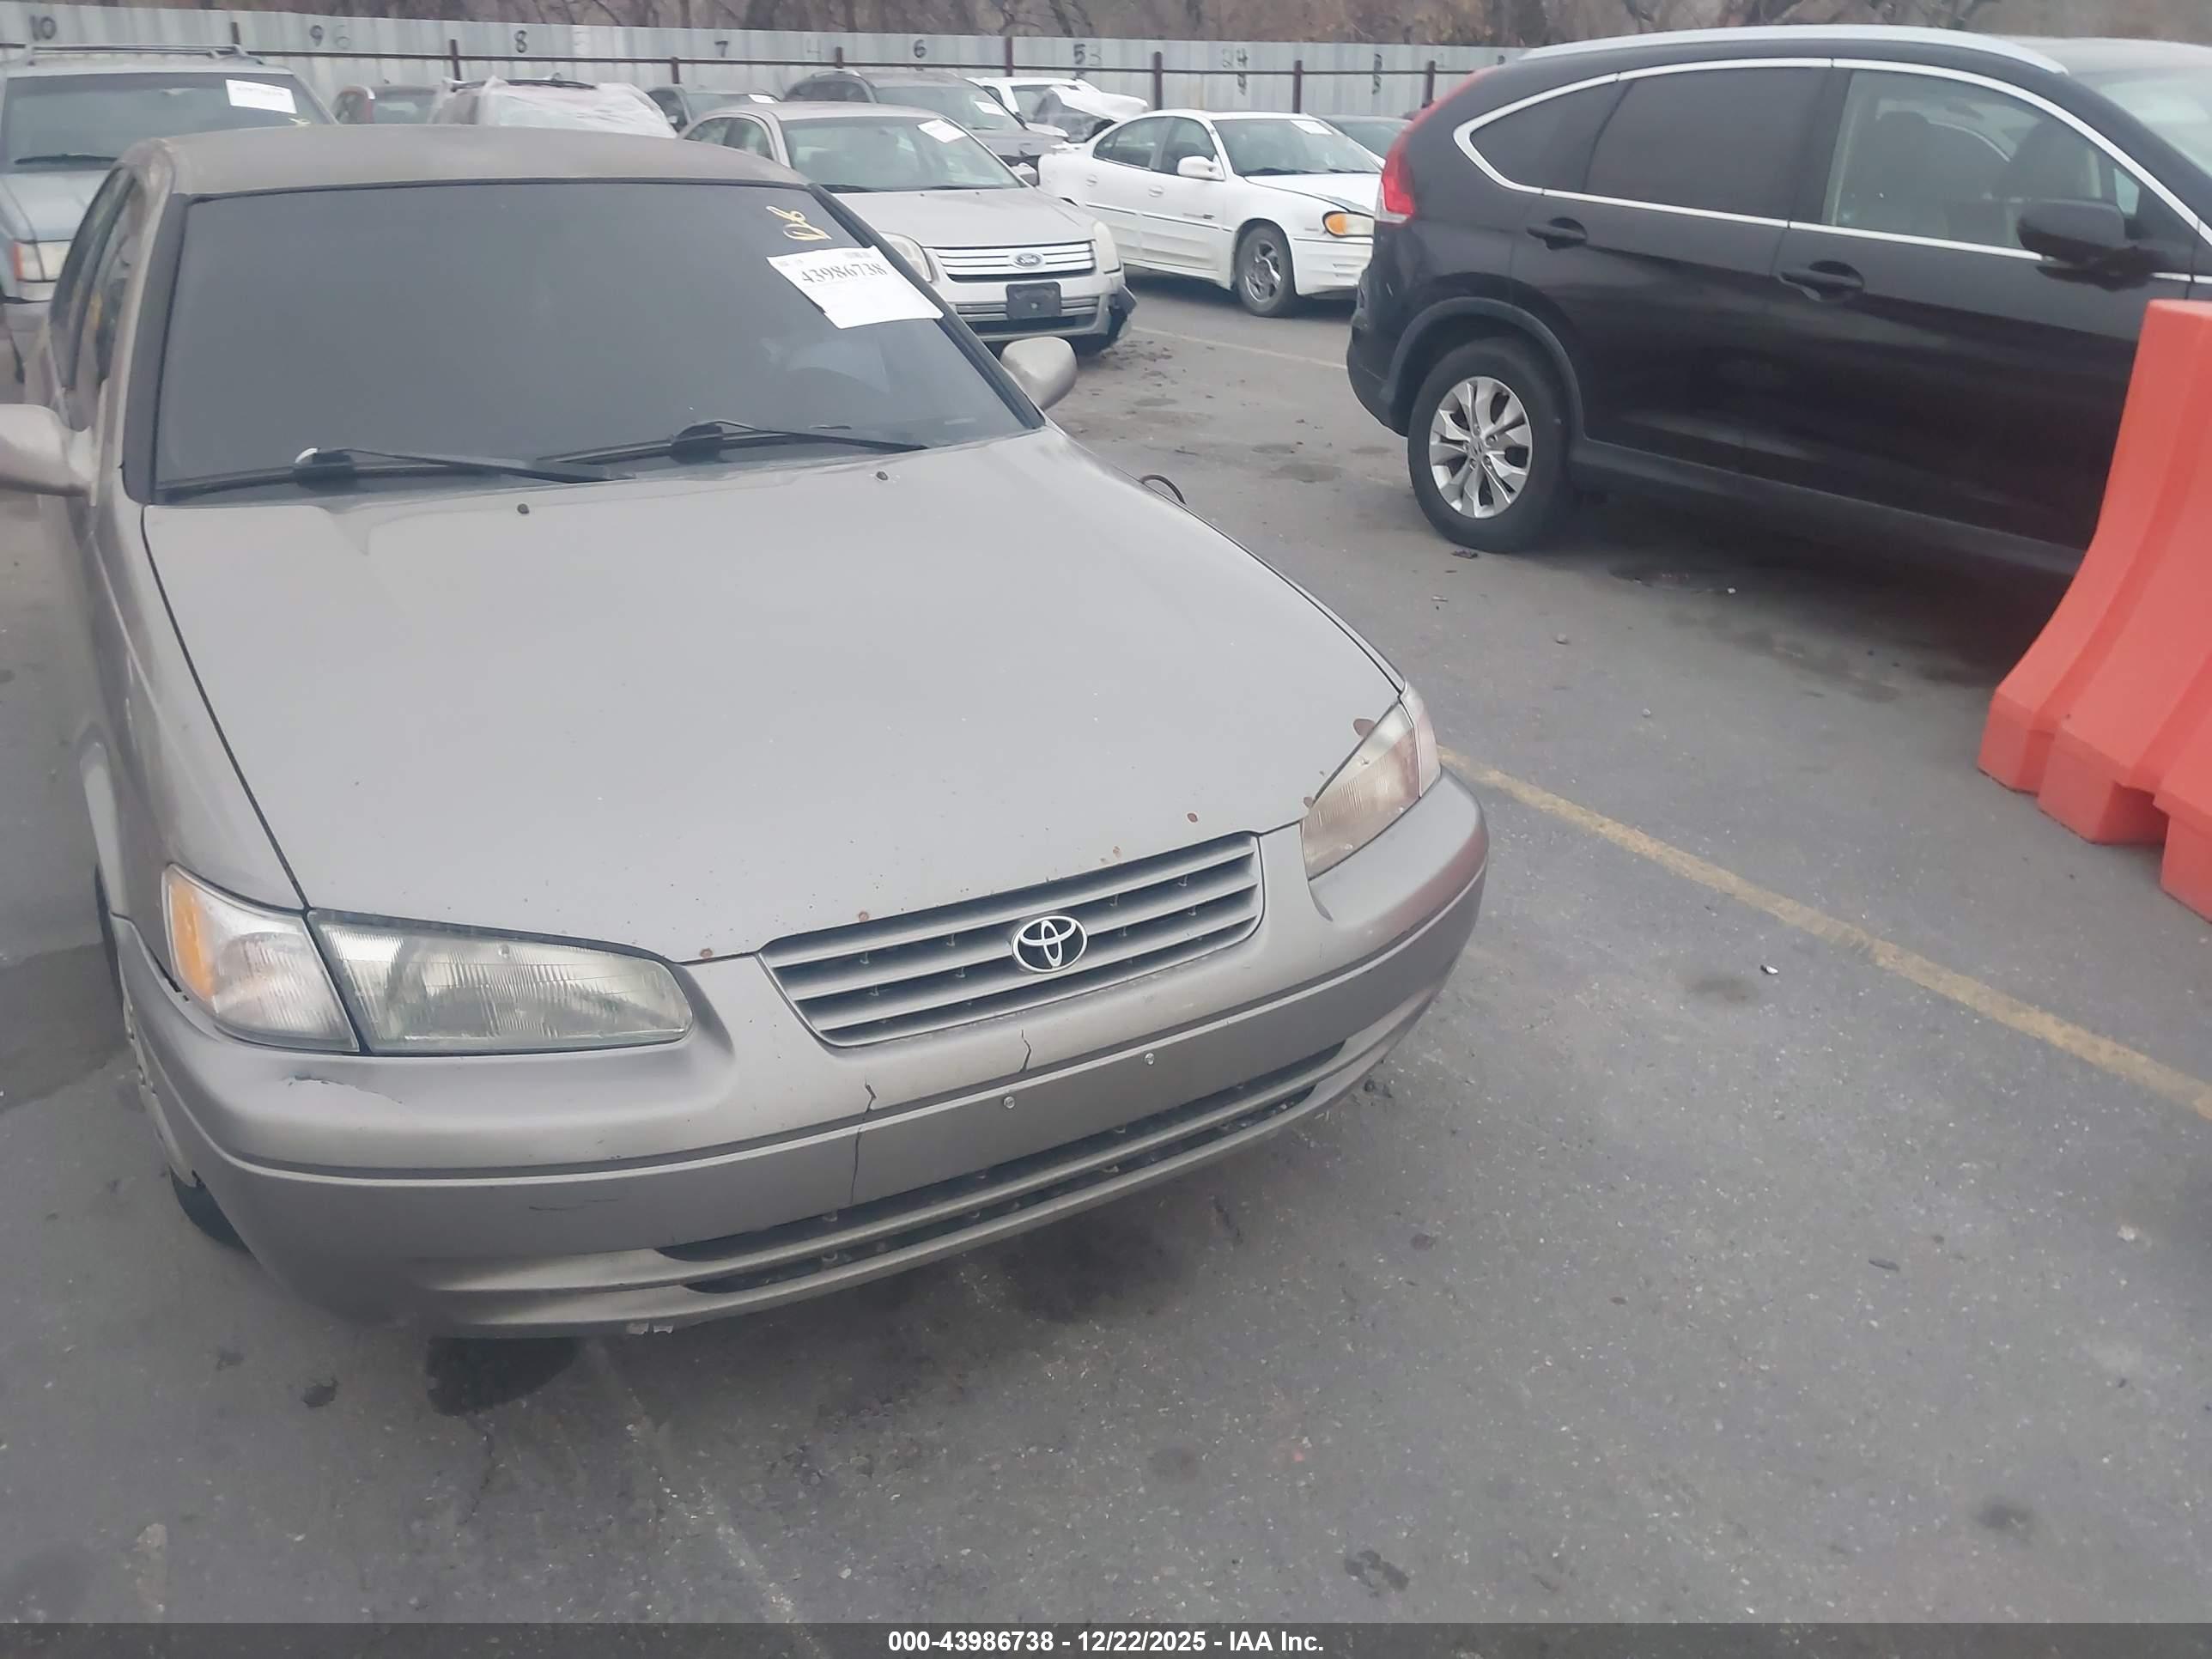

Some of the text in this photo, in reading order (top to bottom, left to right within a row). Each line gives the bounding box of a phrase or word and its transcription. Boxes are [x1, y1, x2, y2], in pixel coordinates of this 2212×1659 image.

[515, 29, 528, 53] 8
[714, 40, 729, 58] 7
[913, 39, 927, 58] 6
[801, 262, 888, 284] 43986738
